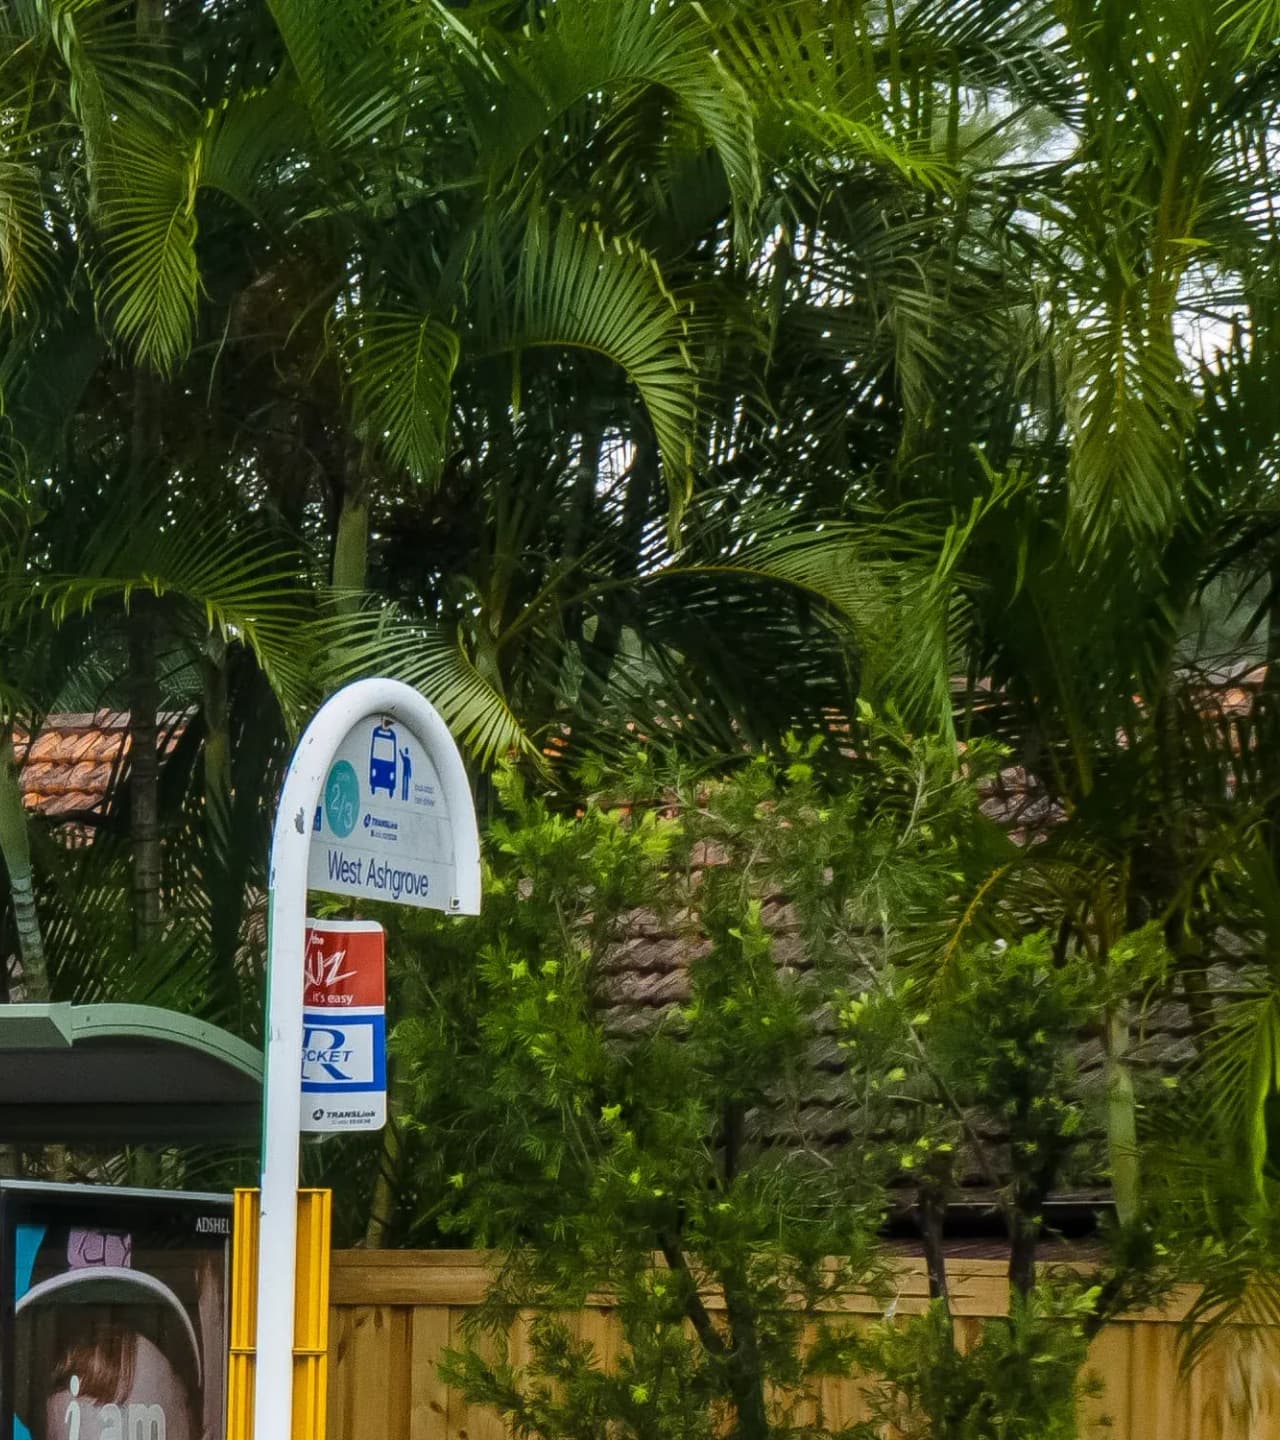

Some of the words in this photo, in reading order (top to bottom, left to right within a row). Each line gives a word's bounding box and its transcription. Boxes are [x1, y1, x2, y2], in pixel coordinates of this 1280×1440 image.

[328, 850, 361, 885] West
[367, 858, 429, 899] Ashgrove
[304, 949, 357, 990] UZ
[313, 991, 326, 1004] it's
[328, 994, 354, 1006] easy
[302, 1049, 353, 1063] CKET
[327, 1110, 376, 1119] TRANSLink
[195, 1217, 231, 1234] ADSHEL
